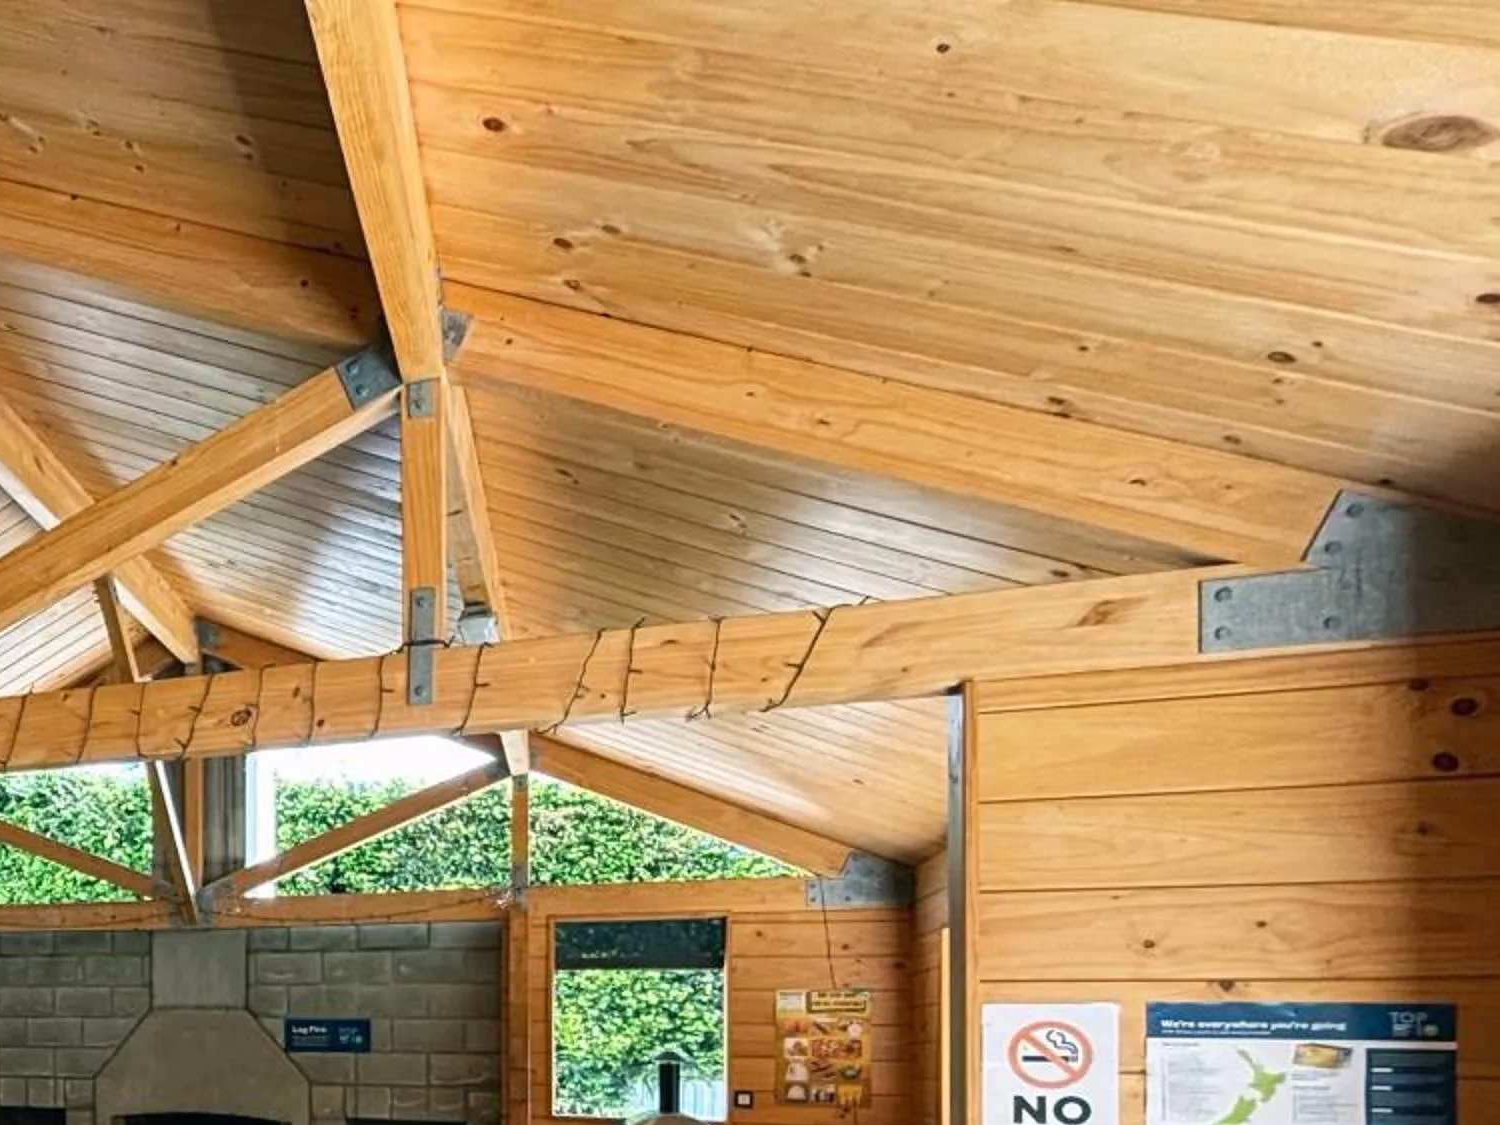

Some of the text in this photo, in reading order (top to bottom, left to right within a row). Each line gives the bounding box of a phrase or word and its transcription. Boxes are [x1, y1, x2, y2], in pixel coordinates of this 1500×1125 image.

[1160, 1019, 1195, 1029] We're
[1197, 1020, 1269, 1032] everywhere
[1270, 1021, 1309, 1032] you're
[1311, 1022, 1346, 1032] going
[1013, 1095, 1092, 1125] NO
